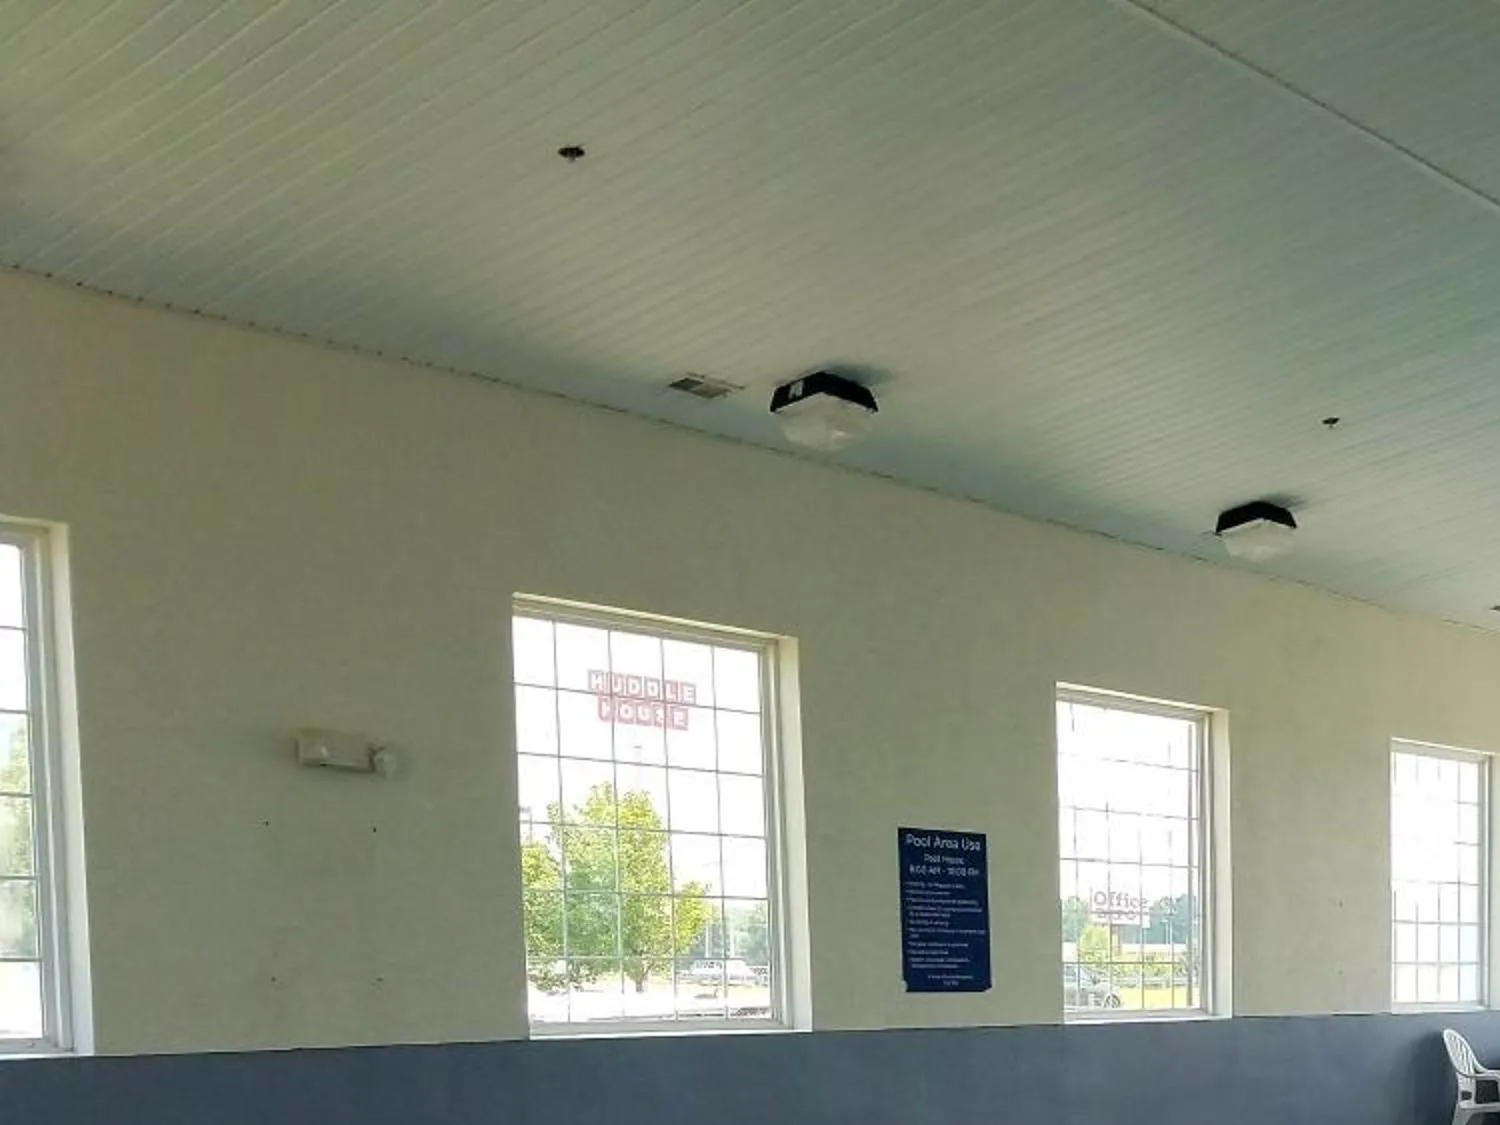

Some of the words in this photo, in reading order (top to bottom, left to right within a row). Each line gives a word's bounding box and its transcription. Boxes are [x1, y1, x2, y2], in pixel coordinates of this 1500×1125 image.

[590, 671, 696, 704] HUDDLE
[904, 834, 931, 848] Pool
[933, 835, 958, 849] Area
[961, 837, 981, 851] Use
[1094, 891, 1148, 909] Office
